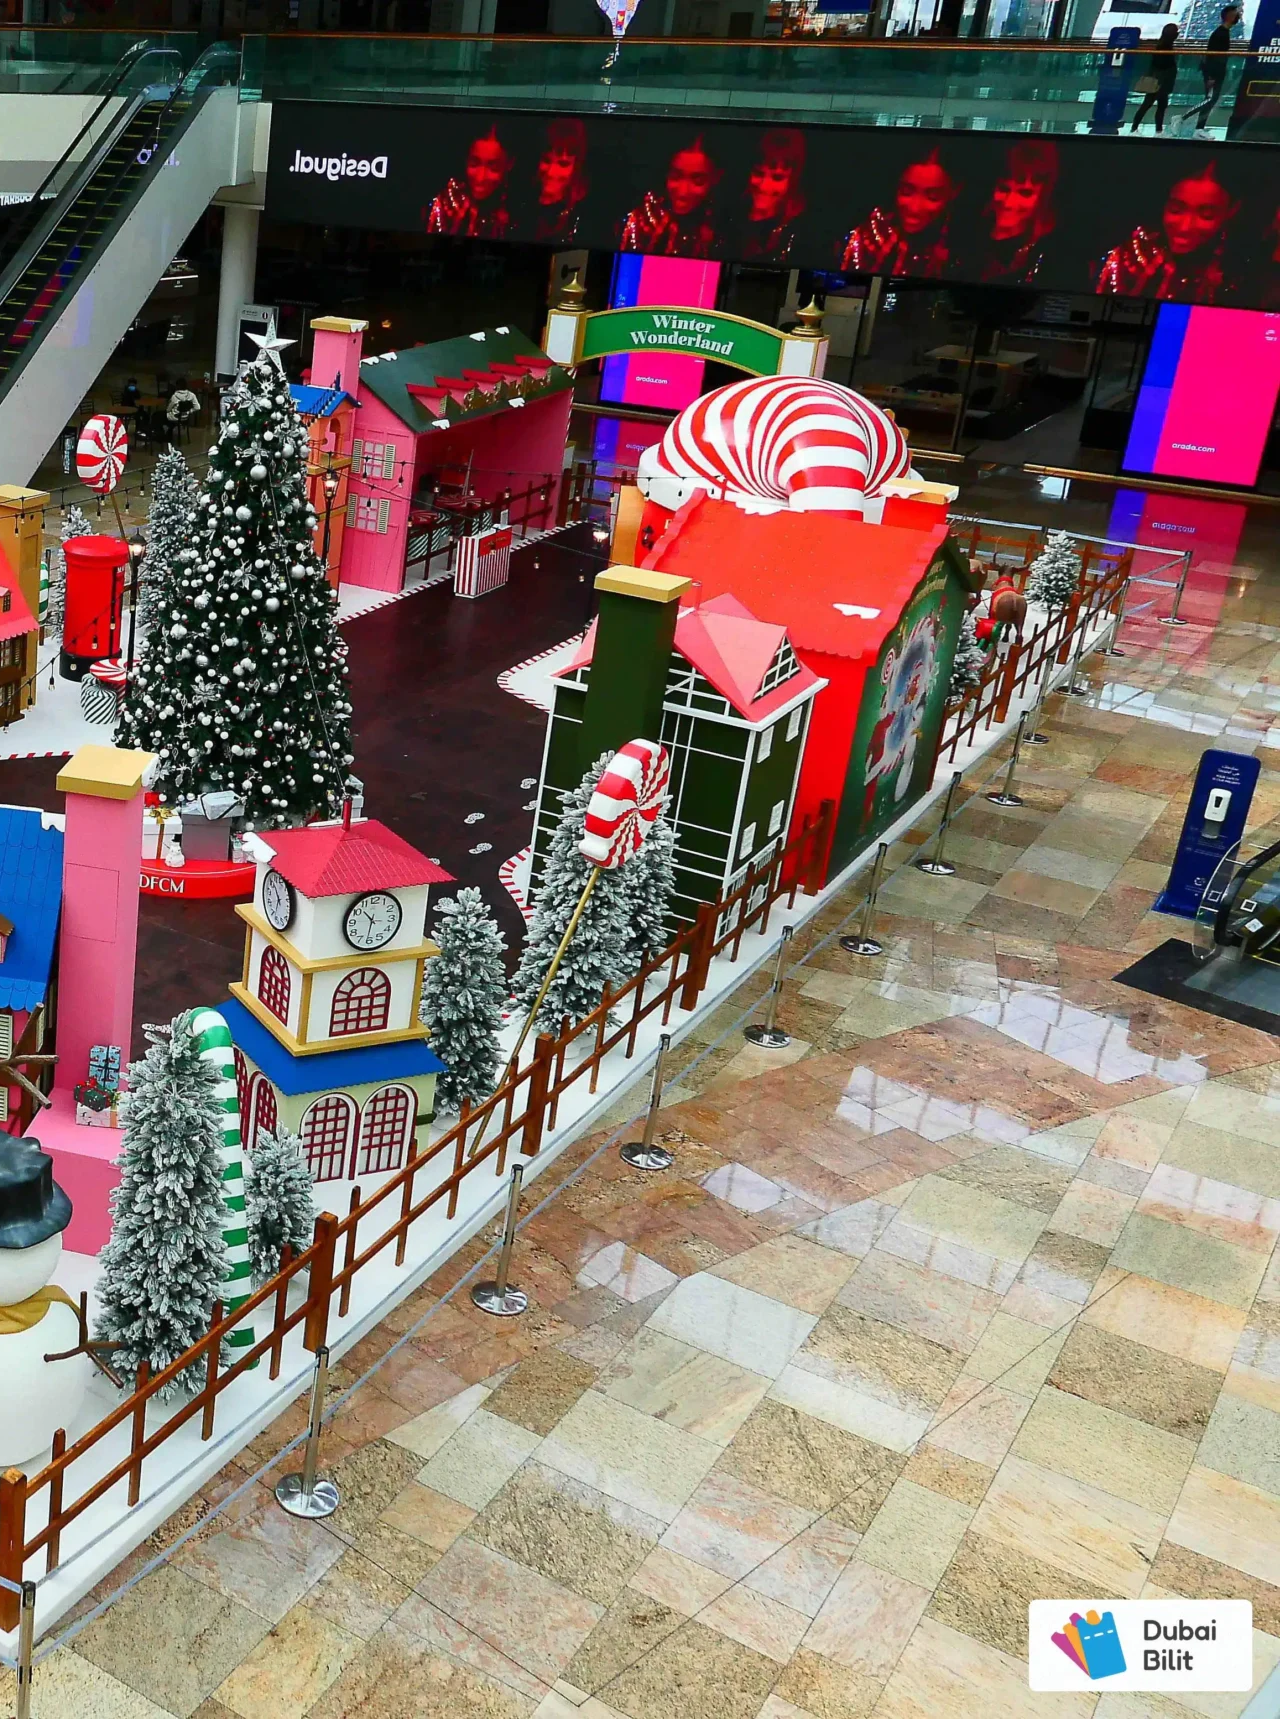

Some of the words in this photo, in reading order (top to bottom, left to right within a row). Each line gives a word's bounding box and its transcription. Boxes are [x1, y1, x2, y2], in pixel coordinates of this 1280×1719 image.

[652, 314, 716, 335] Winter
[630, 330, 734, 356] Wonderland
[635, 375, 668, 385] arada.com
[1171, 441, 1216, 453] arada.com
[361, 900, 368, 908] 11
[370, 897, 381, 905] 12
[353, 908, 362, 916] 10
[387, 905, 394, 913] 2
[349, 919, 357, 927] 9
[388, 915, 395, 923] 3
[349, 929, 357, 937] 8
[375, 933, 384, 941] 5
[356, 935, 364, 943] 7
[365, 936, 373, 944] 6
